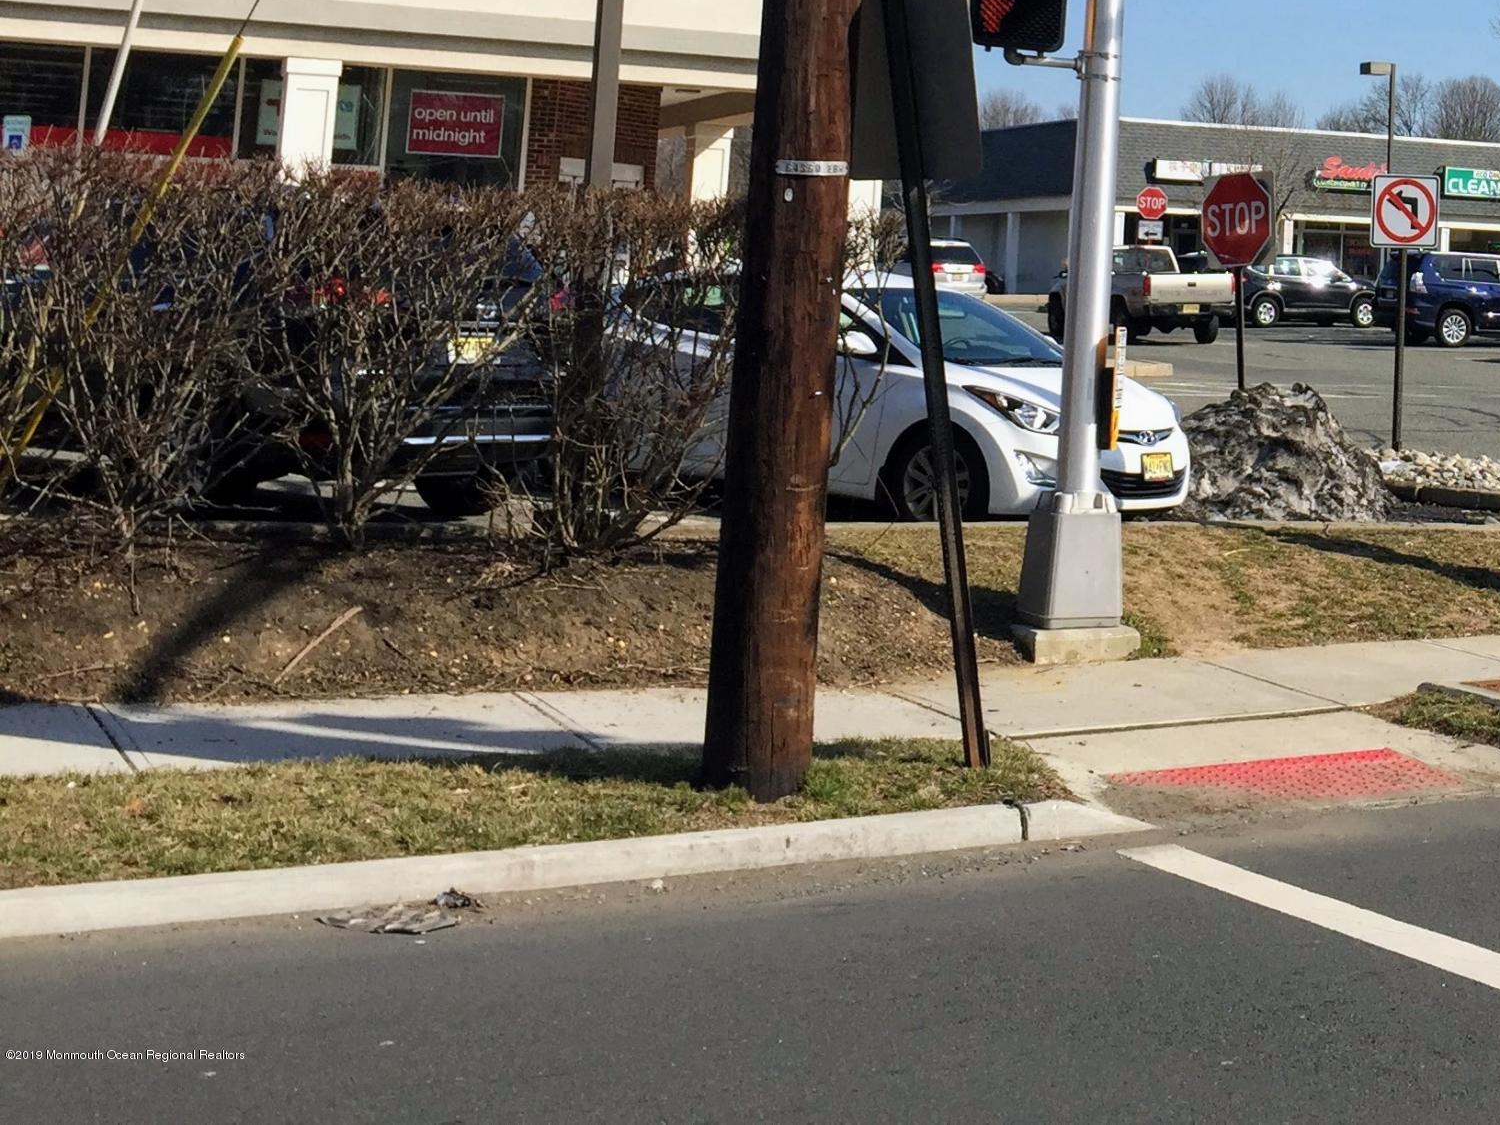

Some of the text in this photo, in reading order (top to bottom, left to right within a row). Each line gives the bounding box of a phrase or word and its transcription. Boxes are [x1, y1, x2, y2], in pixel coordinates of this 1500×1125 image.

[414, 106, 495, 124] open until
[412, 127, 487, 146] midnight
[1139, 196, 1166, 210] STOP
[1207, 200, 1265, 238] STOP
